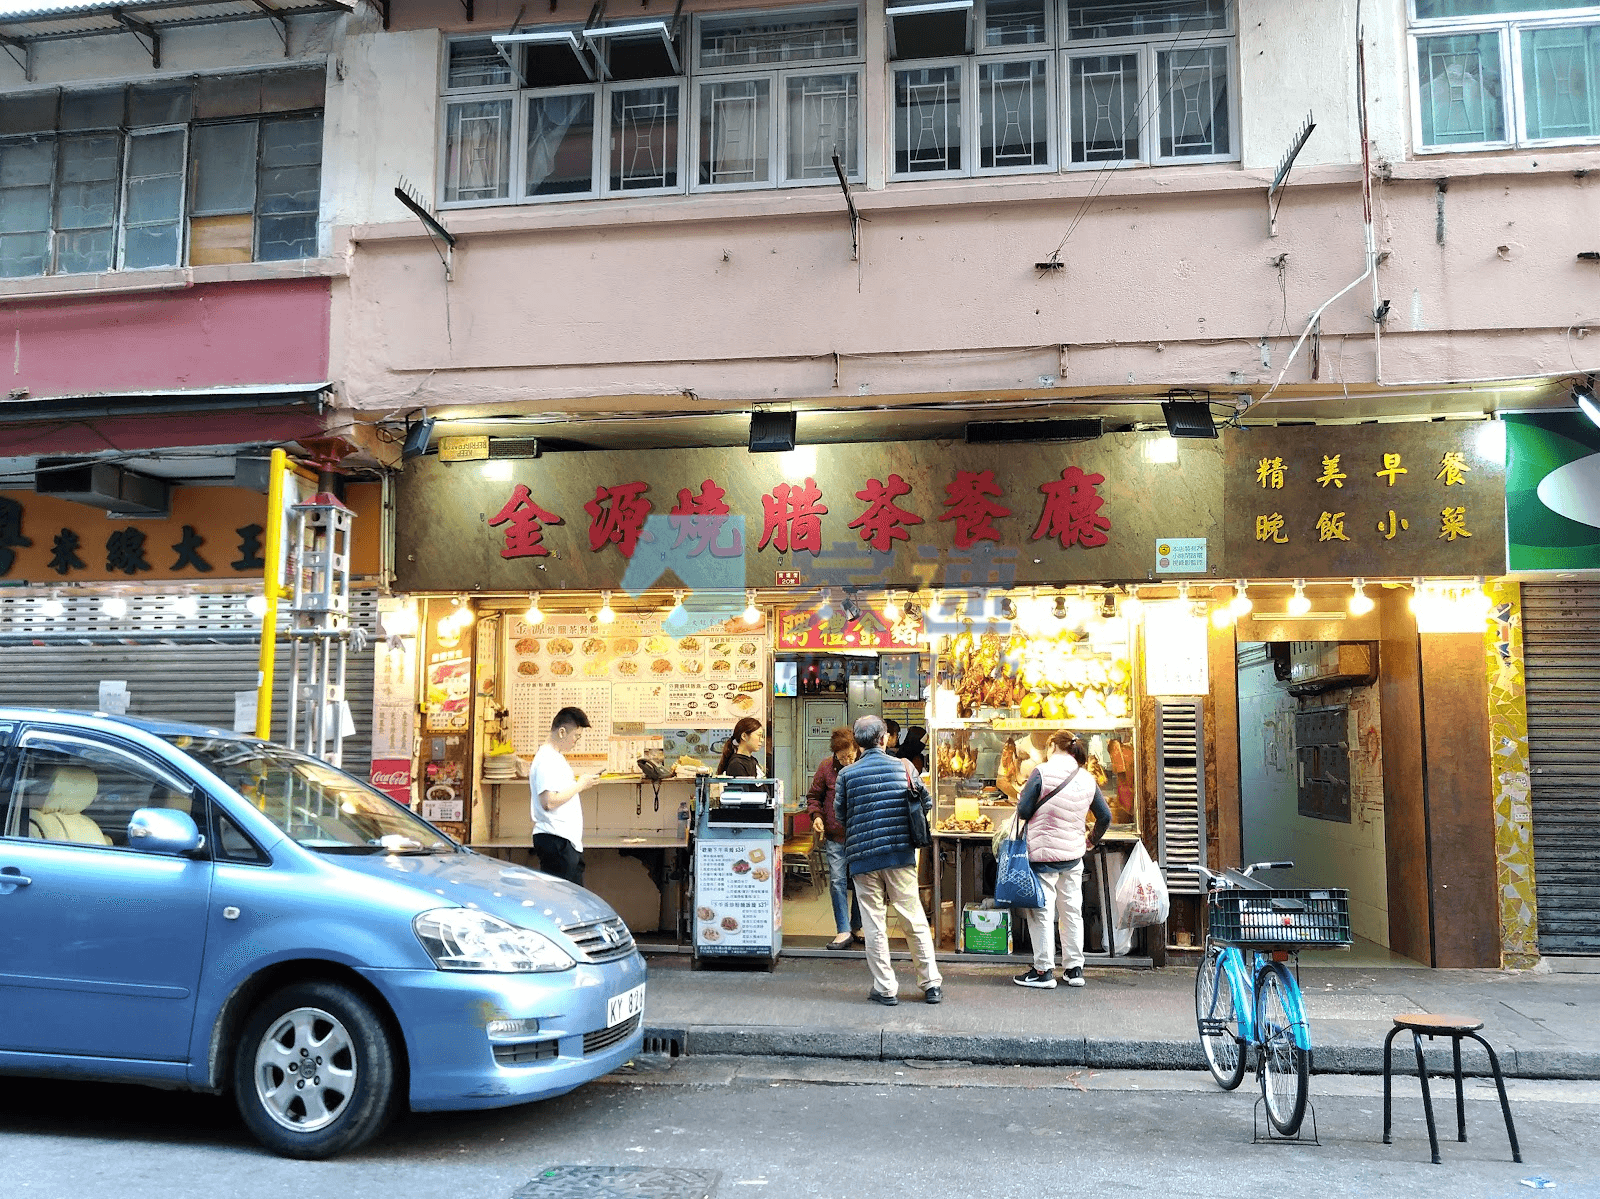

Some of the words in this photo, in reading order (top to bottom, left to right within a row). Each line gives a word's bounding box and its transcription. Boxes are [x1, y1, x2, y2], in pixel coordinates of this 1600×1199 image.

[1256, 452, 1471, 489] 精美早餐
[488, 466, 1111, 558] 金源燒臘茶餐廳
[1256, 506, 1472, 544] 晚飯小菜
[47, 524, 264, 575] 米線大王
[781, 612, 920, 647] 聘禮金豬
[610, 998, 622, 1023] KY
